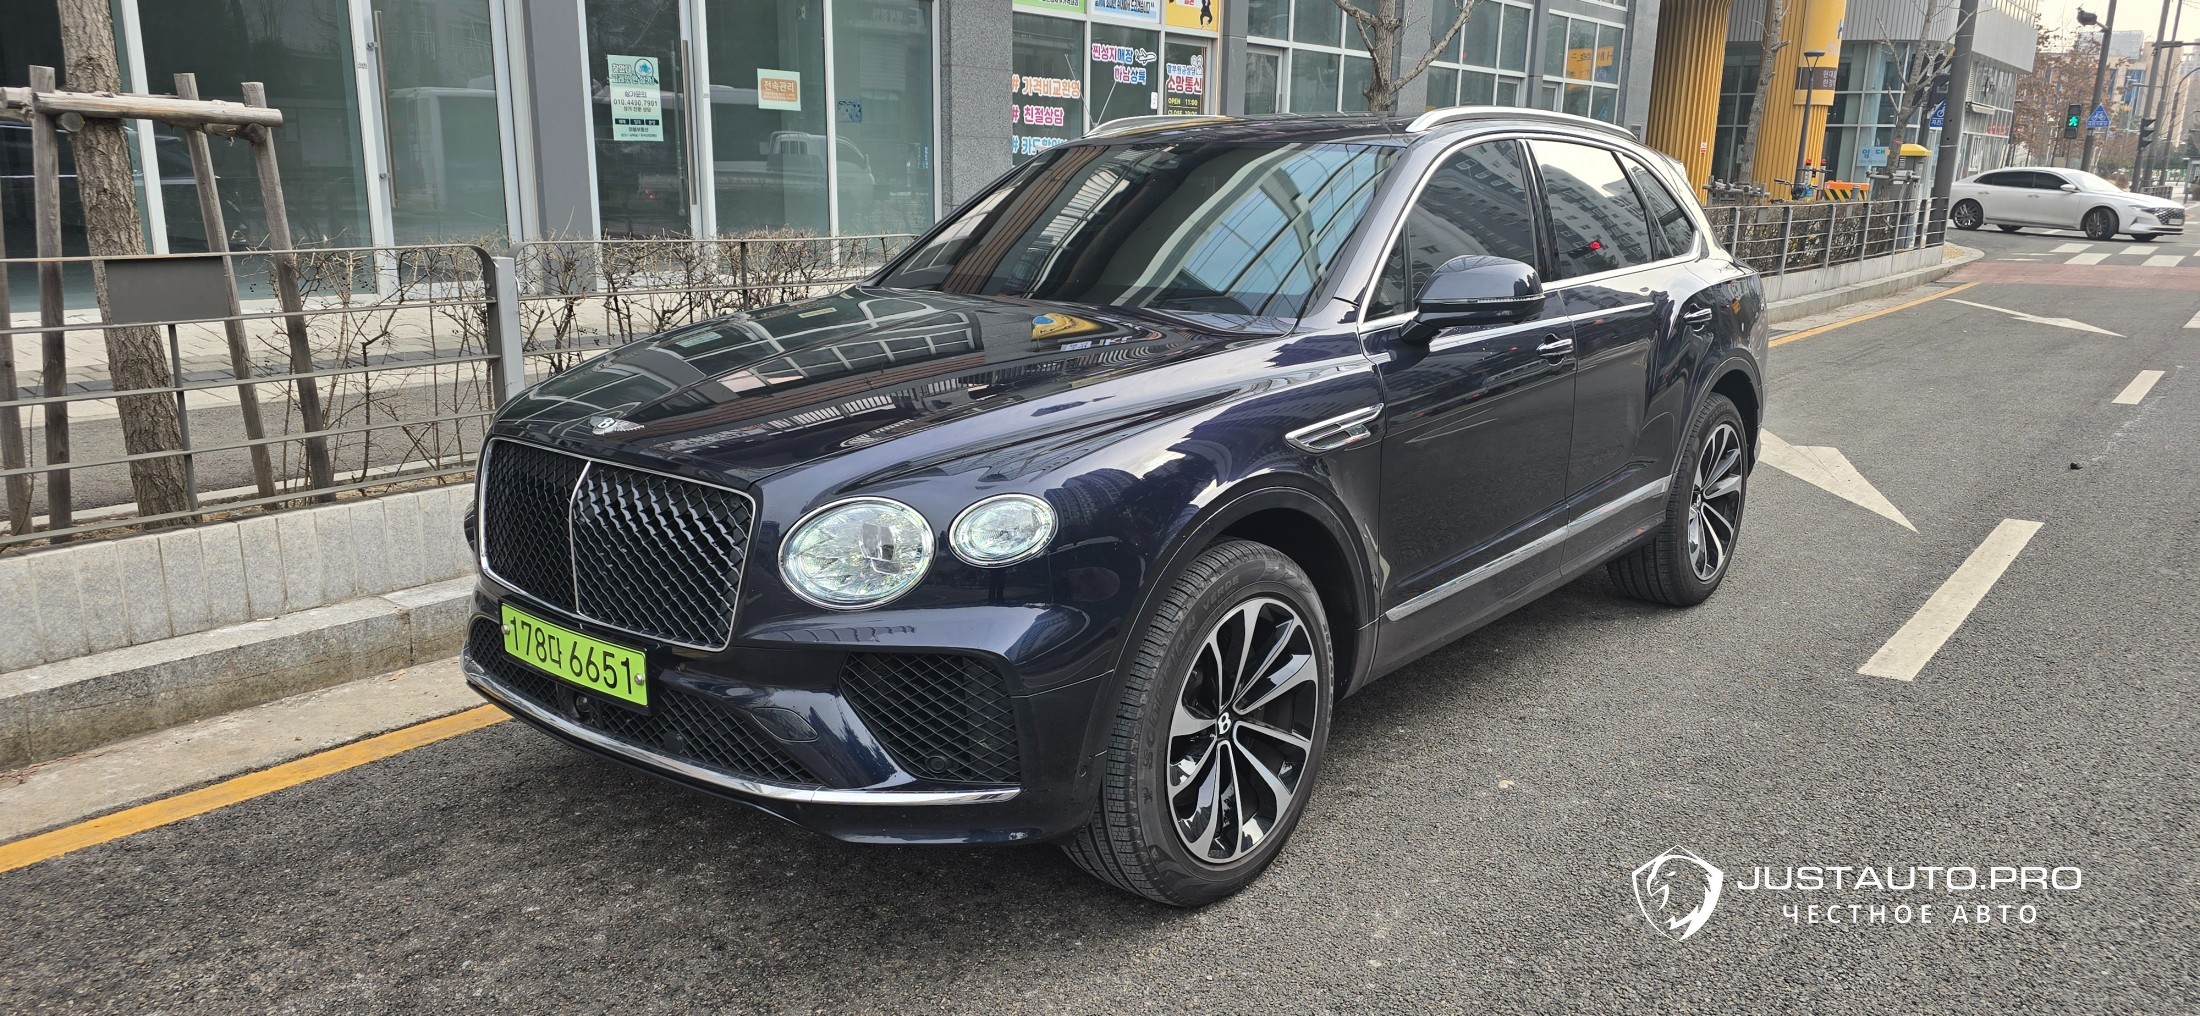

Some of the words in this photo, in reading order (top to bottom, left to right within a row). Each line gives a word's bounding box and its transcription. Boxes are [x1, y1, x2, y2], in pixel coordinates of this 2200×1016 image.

[1092, 43, 1133, 64] 찐성지매장
[1114, 65, 1146, 85] 하남상륙
[1167, 75, 1202, 94] 소망통신
[764, 80, 794, 92] 전속관리
[1022, 76, 1080, 98] 가격비교환영
[1024, 106, 1064, 126] 친절상담
[510, 616, 562, 669] 178다
[569, 640, 632, 695] 6651
